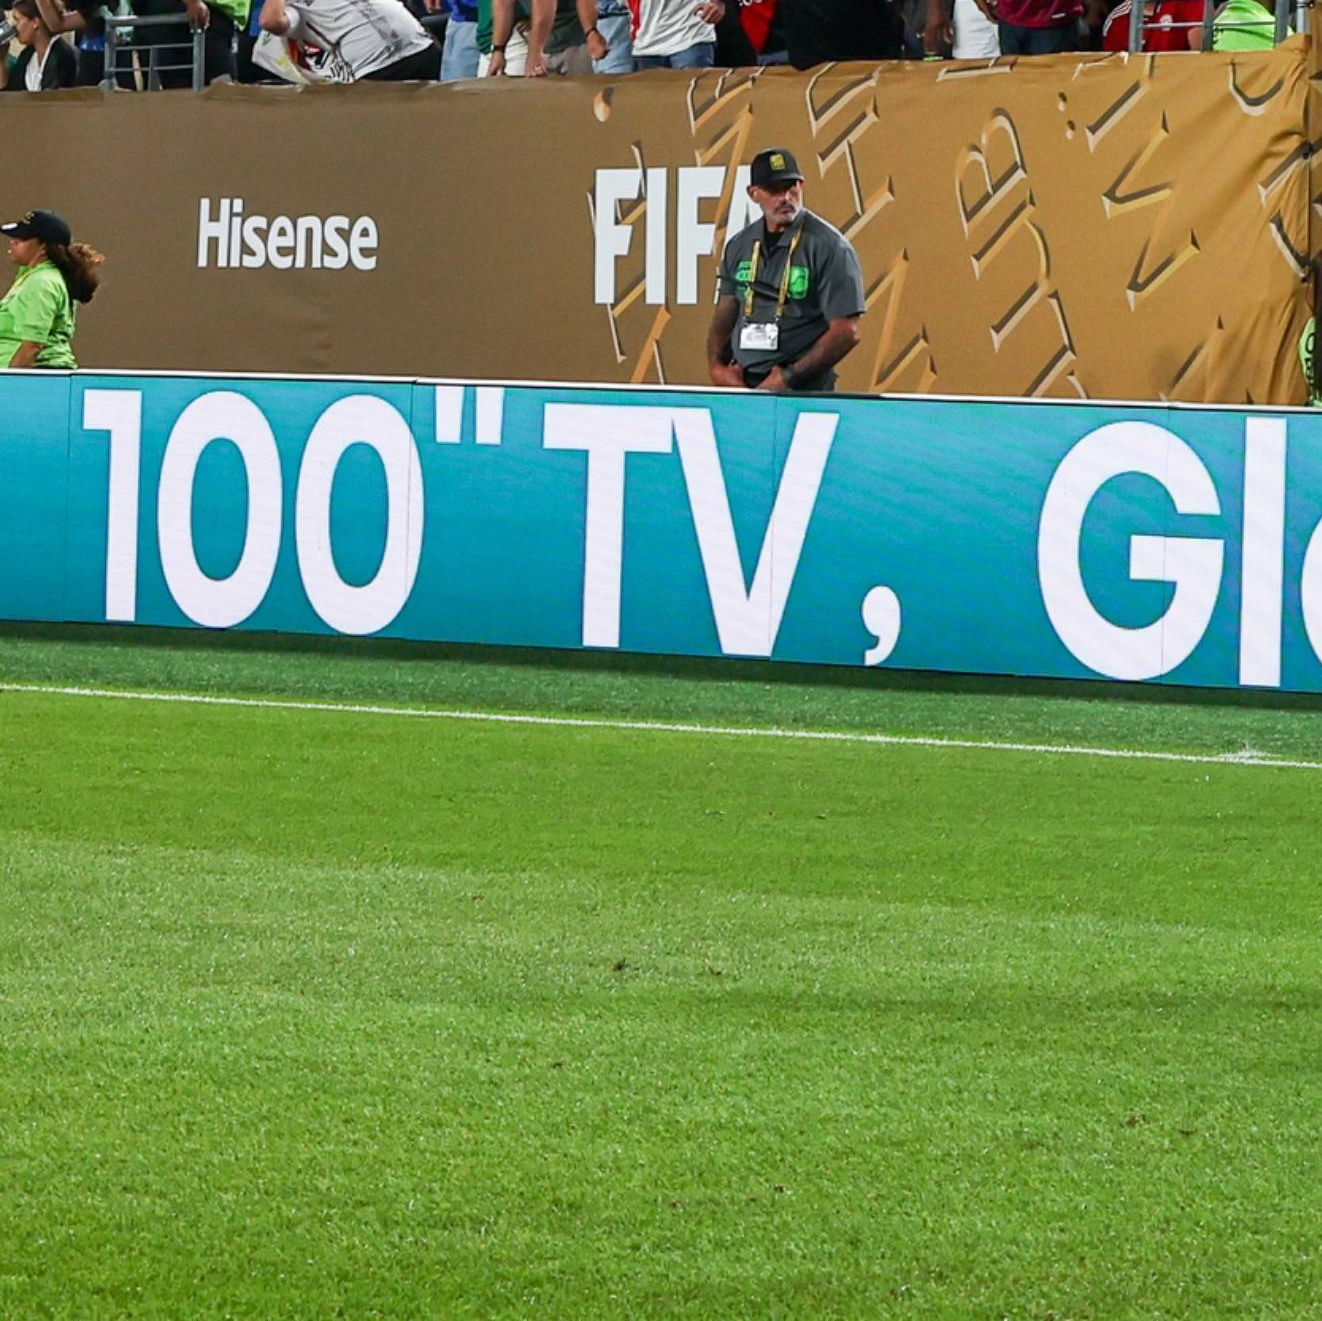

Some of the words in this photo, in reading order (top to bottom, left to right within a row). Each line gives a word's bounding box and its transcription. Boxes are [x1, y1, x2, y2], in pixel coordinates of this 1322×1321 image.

[197, 197, 379, 271] Hisense
[82, 385, 505, 636] 100"
[543, 402, 902, 667] TV,
